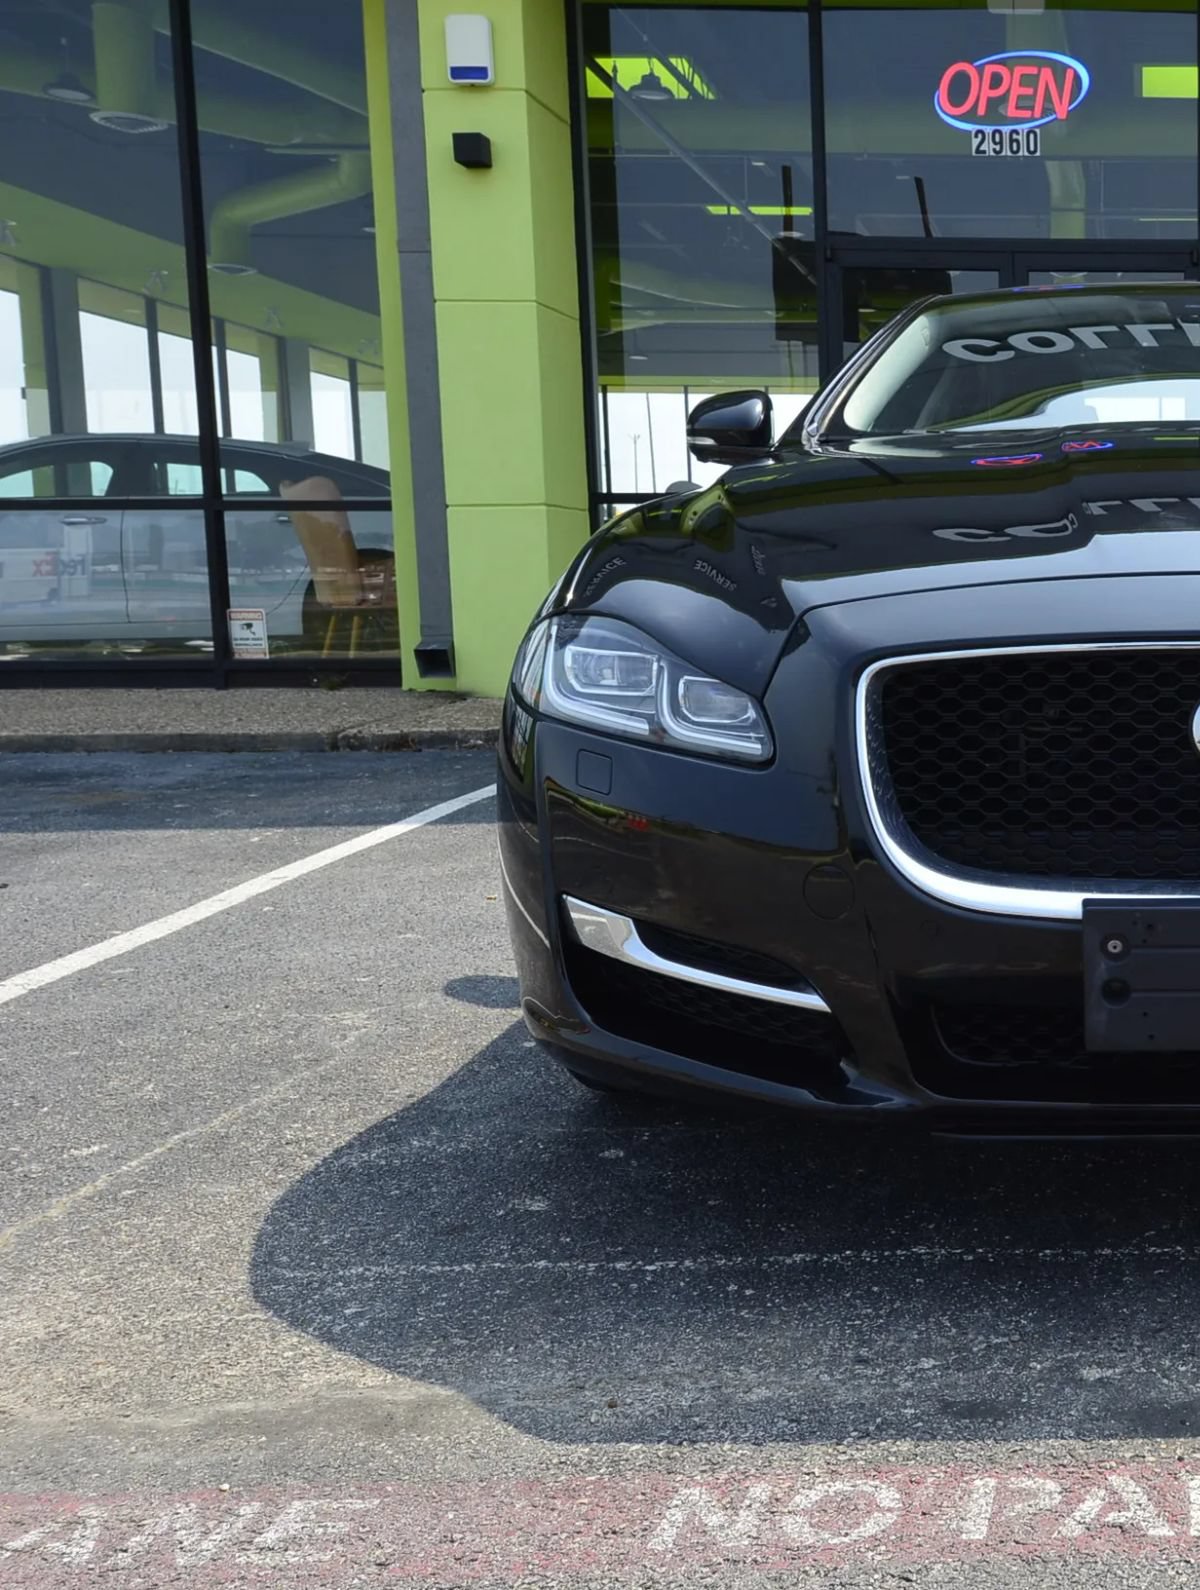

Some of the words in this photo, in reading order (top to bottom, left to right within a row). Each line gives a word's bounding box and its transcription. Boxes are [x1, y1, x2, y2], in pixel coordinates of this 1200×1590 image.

[939, 62, 1075, 119] OPEN
[974, 129, 1039, 155] 2960
[648, 1479, 902, 1550] NO
